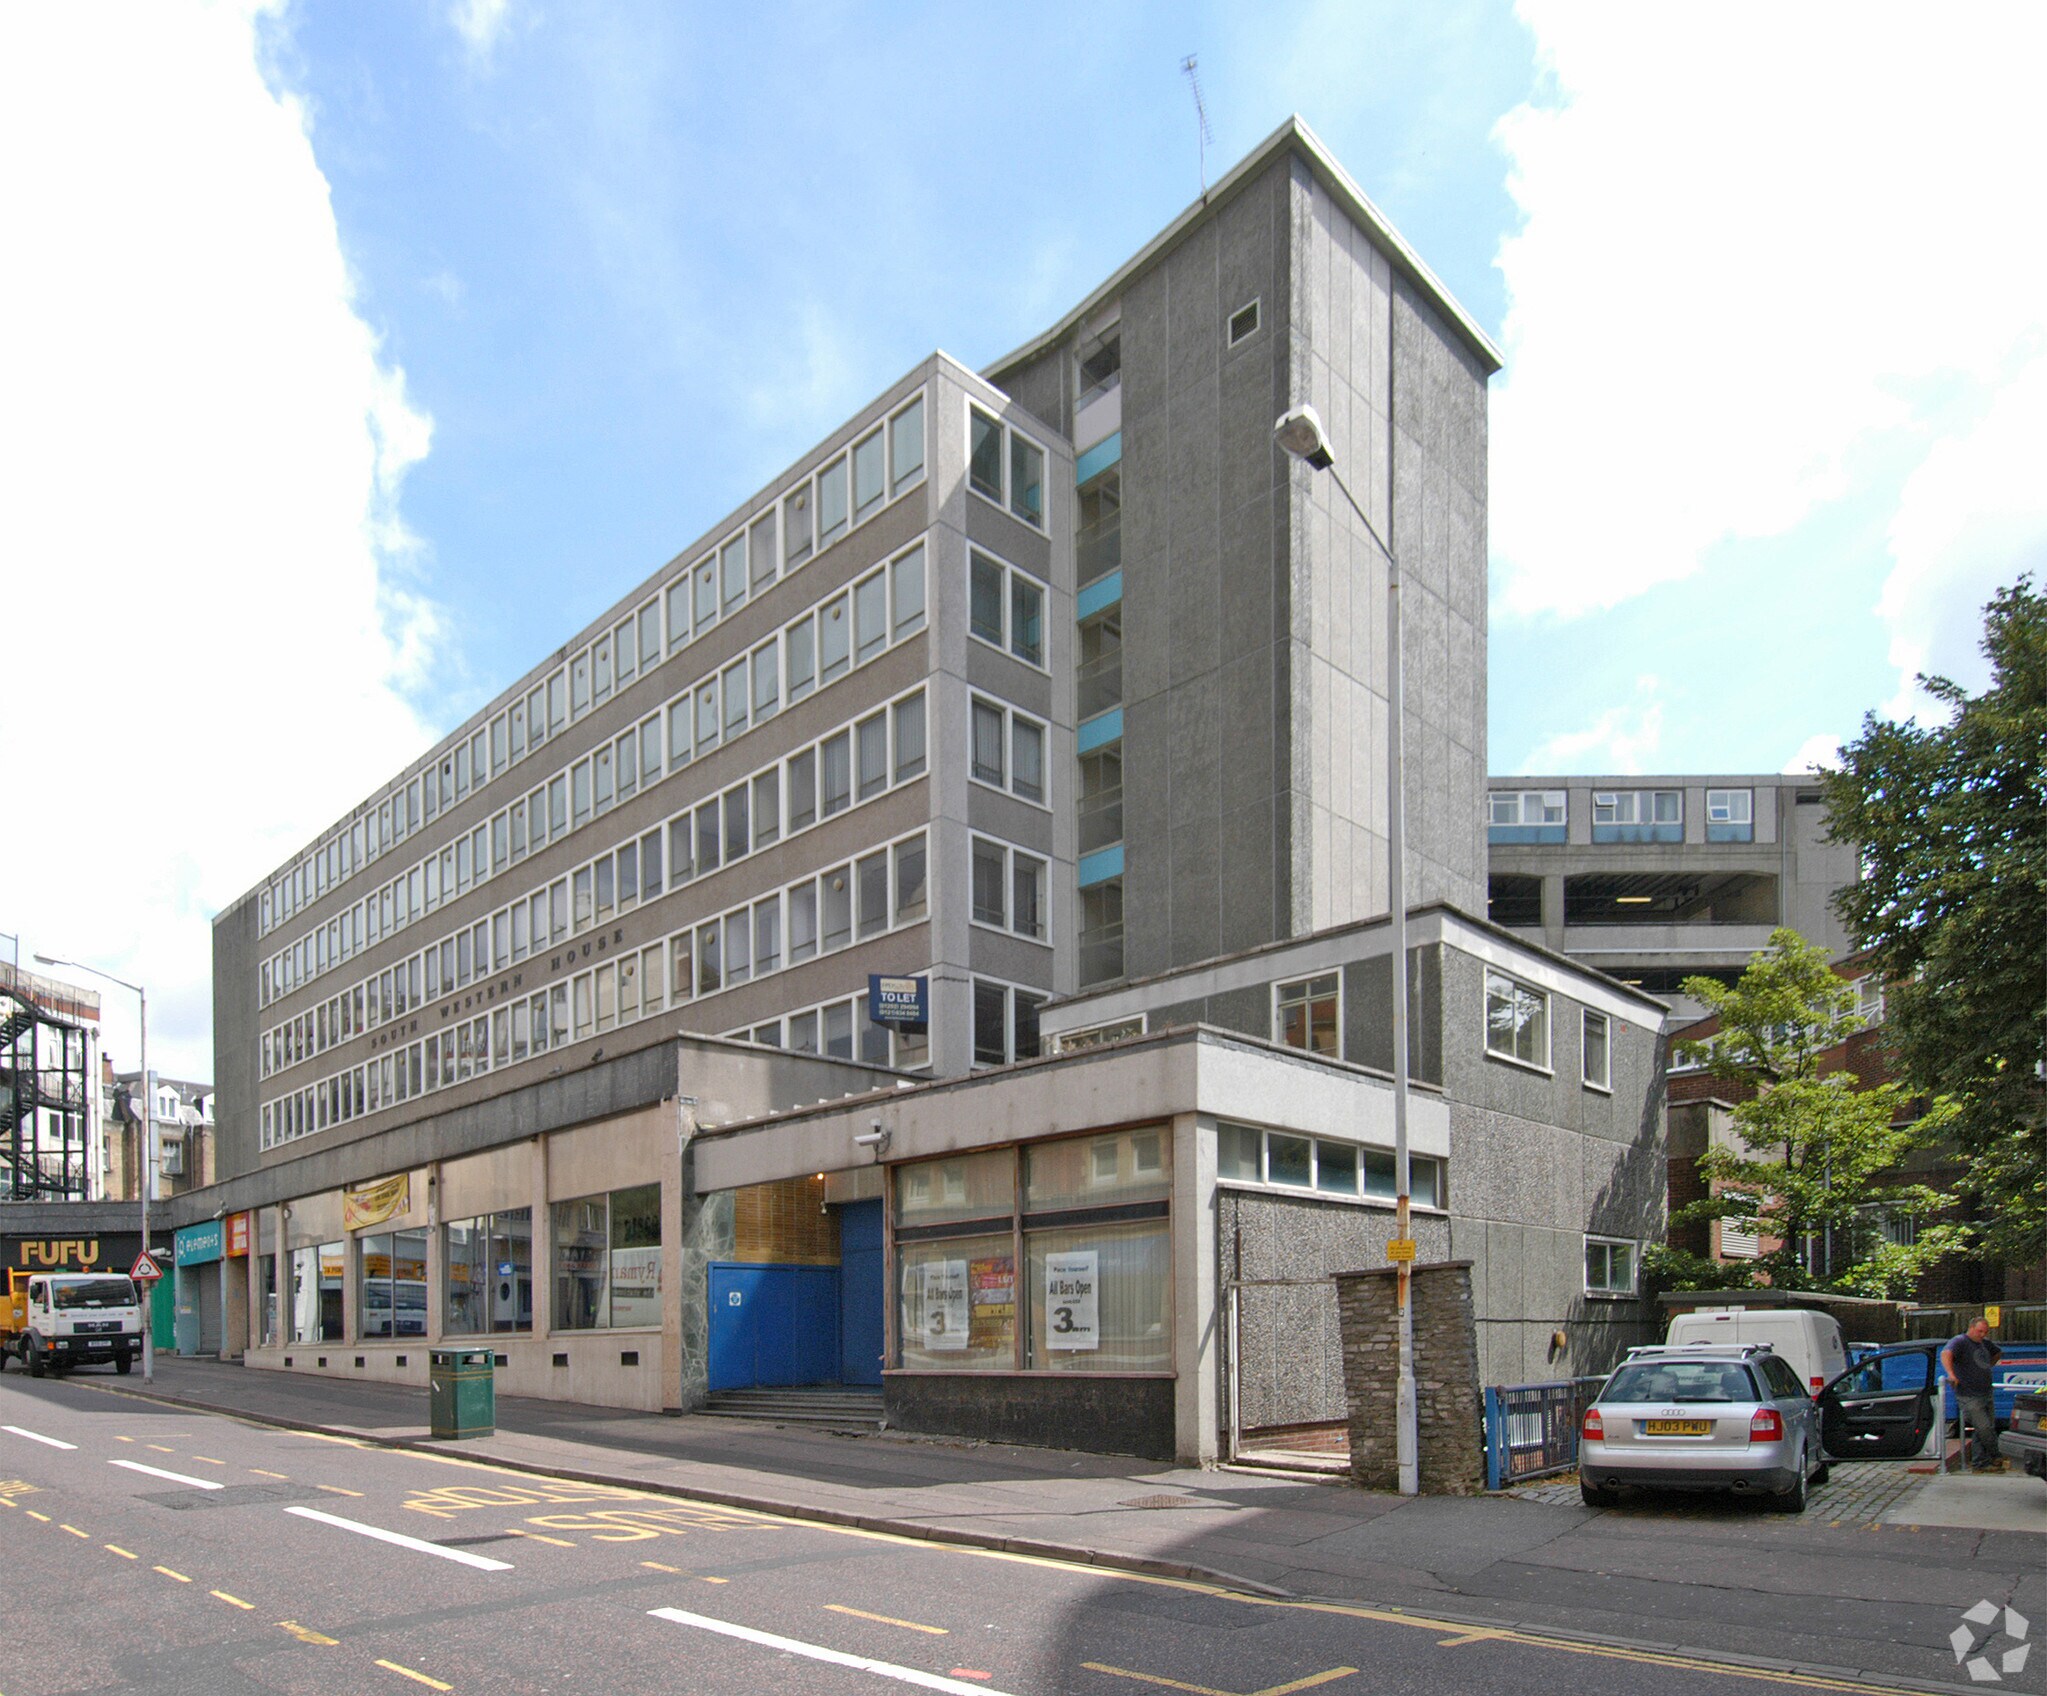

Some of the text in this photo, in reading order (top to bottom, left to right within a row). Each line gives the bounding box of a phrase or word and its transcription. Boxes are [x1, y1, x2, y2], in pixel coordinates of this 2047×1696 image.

[371, 928, 623, 1049] SOUTH WESTERN HOUSE
[881, 992, 917, 1003] TO LET
[21, 1240, 99, 1265] FUFU
[1049, 1279, 1092, 1298] All Bars Open
[1053, 1306, 1091, 1334] 3am
[1647, 1419, 1680, 1432] HJ03
